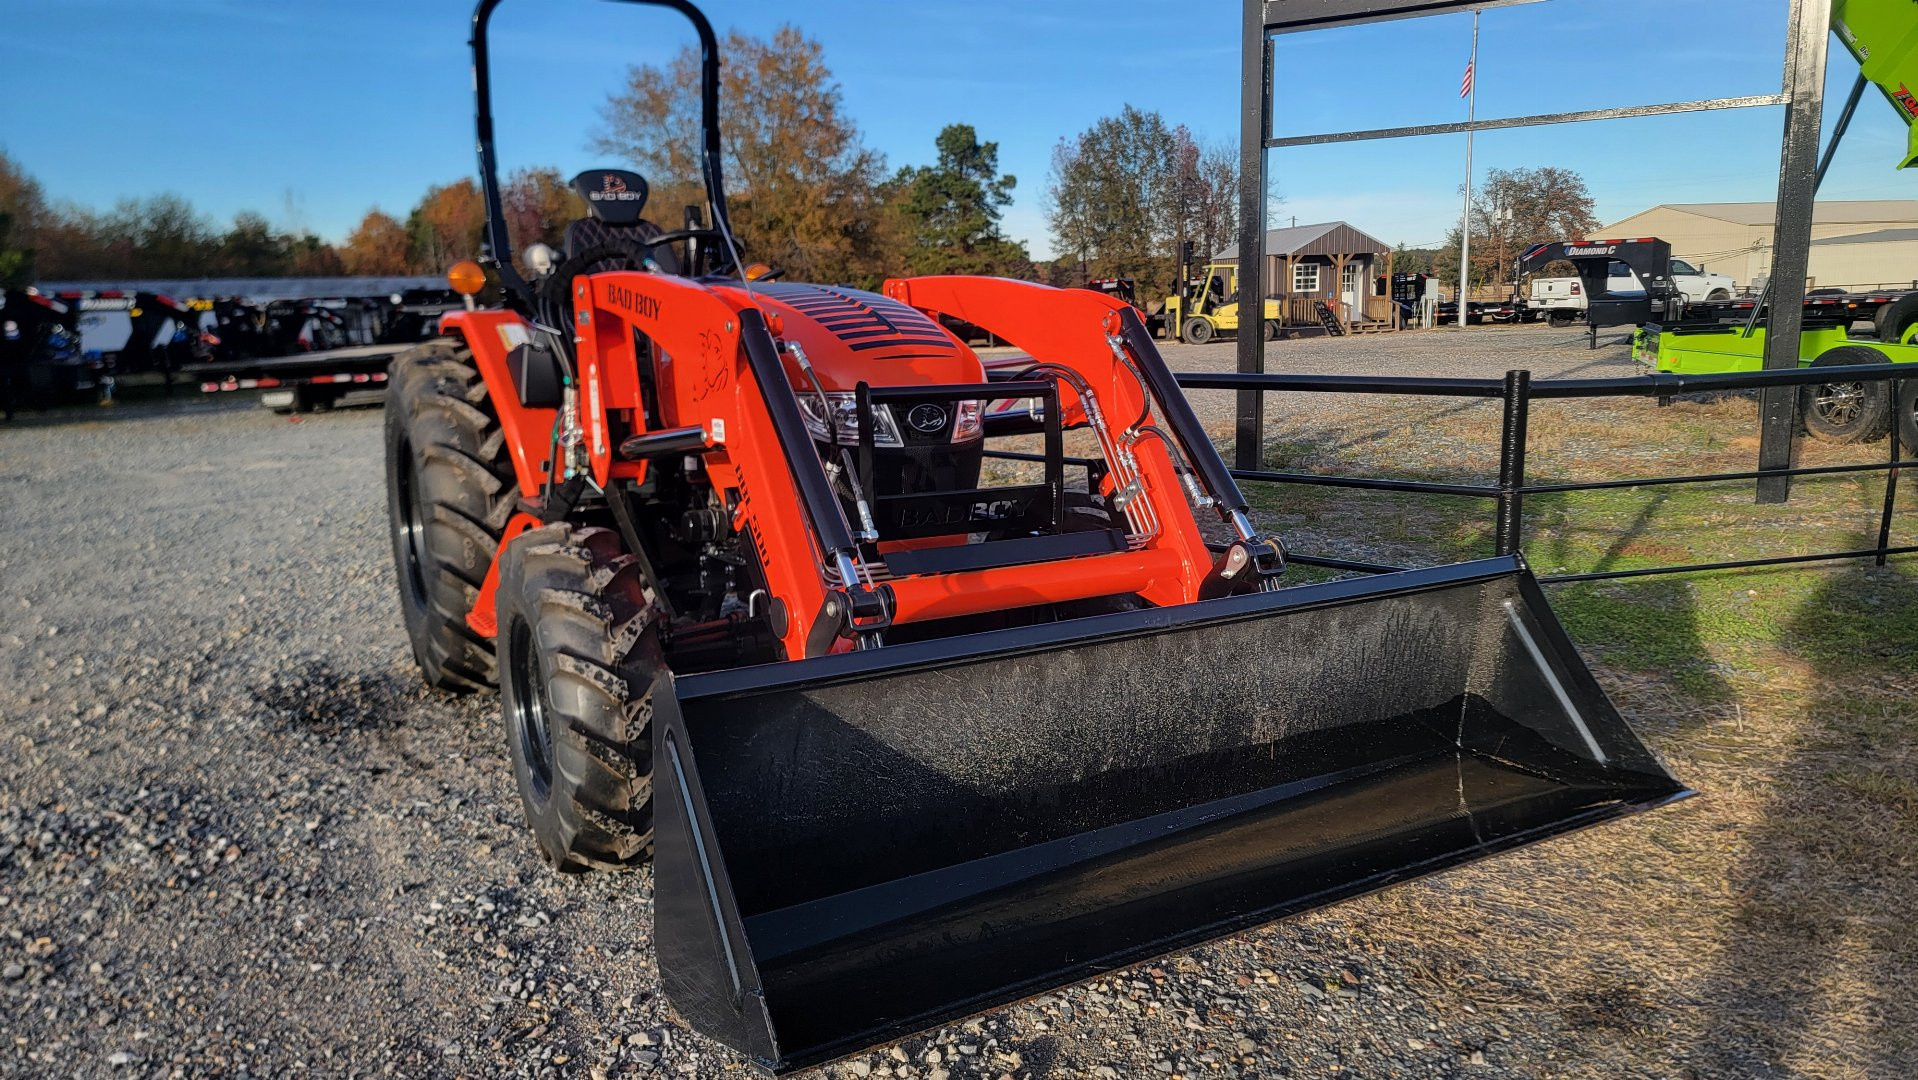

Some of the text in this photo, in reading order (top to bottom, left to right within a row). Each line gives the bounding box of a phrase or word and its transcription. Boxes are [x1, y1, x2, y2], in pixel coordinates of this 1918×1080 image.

[589, 191, 641, 201] BAD BOY
[1569, 246, 1616, 256] DIAMOND C
[608, 283, 662, 321] BAD BOY
